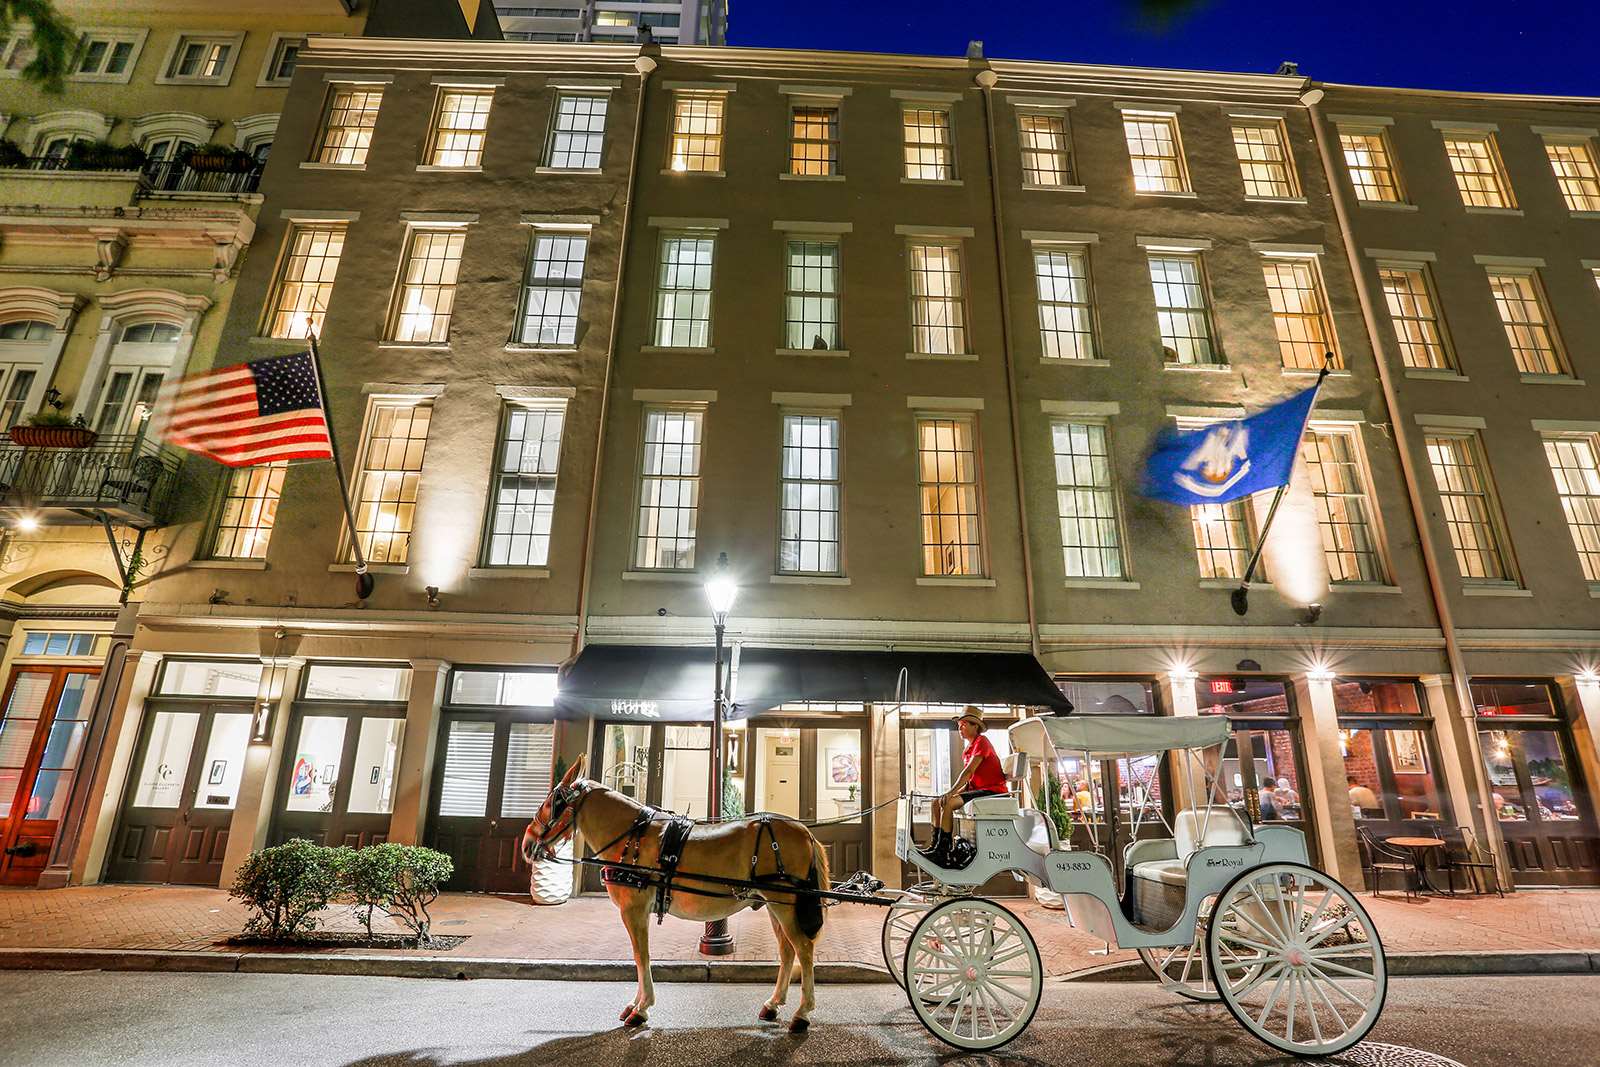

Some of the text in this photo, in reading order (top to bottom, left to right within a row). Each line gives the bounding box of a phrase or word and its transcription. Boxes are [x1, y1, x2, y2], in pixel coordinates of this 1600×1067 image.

[1214, 681, 1230, 693] EXIT
[998, 828, 1009, 837] 03
[988, 851, 1011, 862] Royal
[1056, 862, 1092, 872] 943-8820
